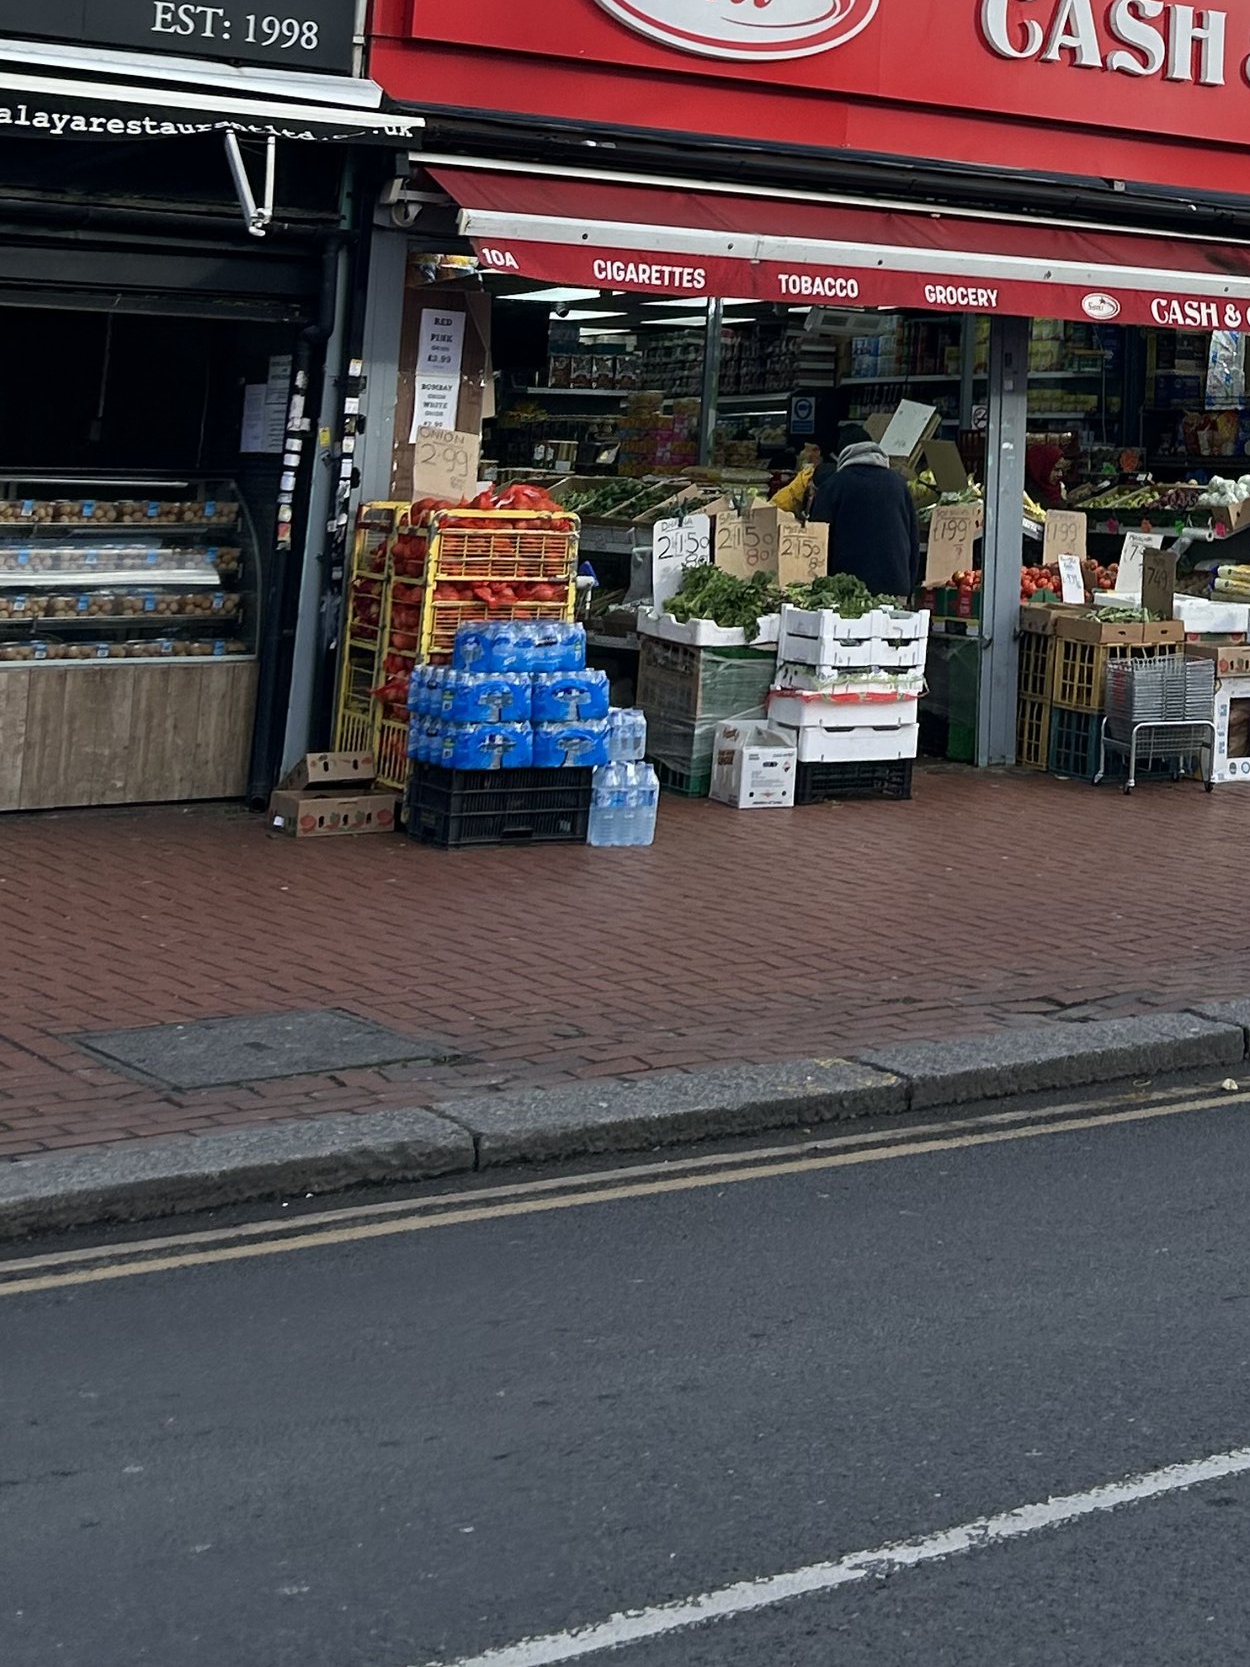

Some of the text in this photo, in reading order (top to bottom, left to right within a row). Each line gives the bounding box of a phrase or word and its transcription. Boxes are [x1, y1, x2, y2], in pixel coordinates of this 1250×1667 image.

[151, 0, 320, 50] EST: 1998
[481, 247, 519, 270] 10A
[593, 259, 706, 290] CIGARETTES
[777, 273, 859, 298] TOBACCO
[924, 283, 999, 308] GROCERY
[433, 317, 453, 327] RED
[1150, 297, 1218, 327] CASH
[1223, 303, 1242, 328] &
[419, 426, 465, 444] ONION
